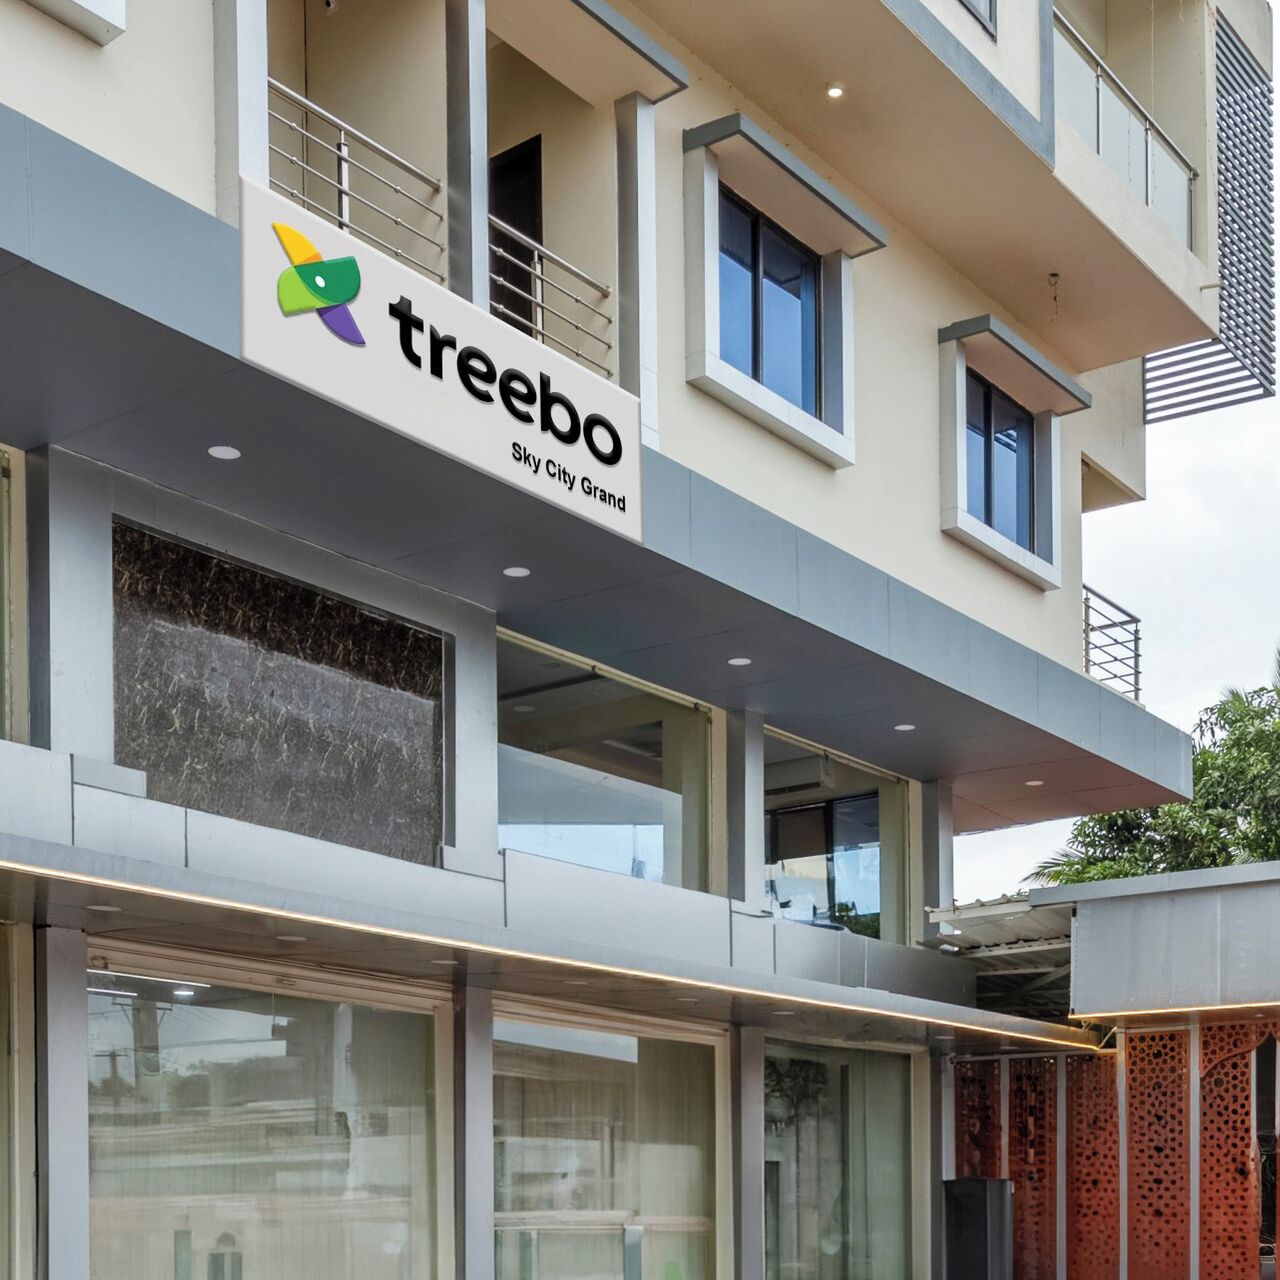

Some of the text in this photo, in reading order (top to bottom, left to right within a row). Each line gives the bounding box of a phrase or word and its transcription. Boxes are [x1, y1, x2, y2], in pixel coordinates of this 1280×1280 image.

[389, 295, 622, 465] treebo
[511, 441, 626, 512] Sky City Grand
